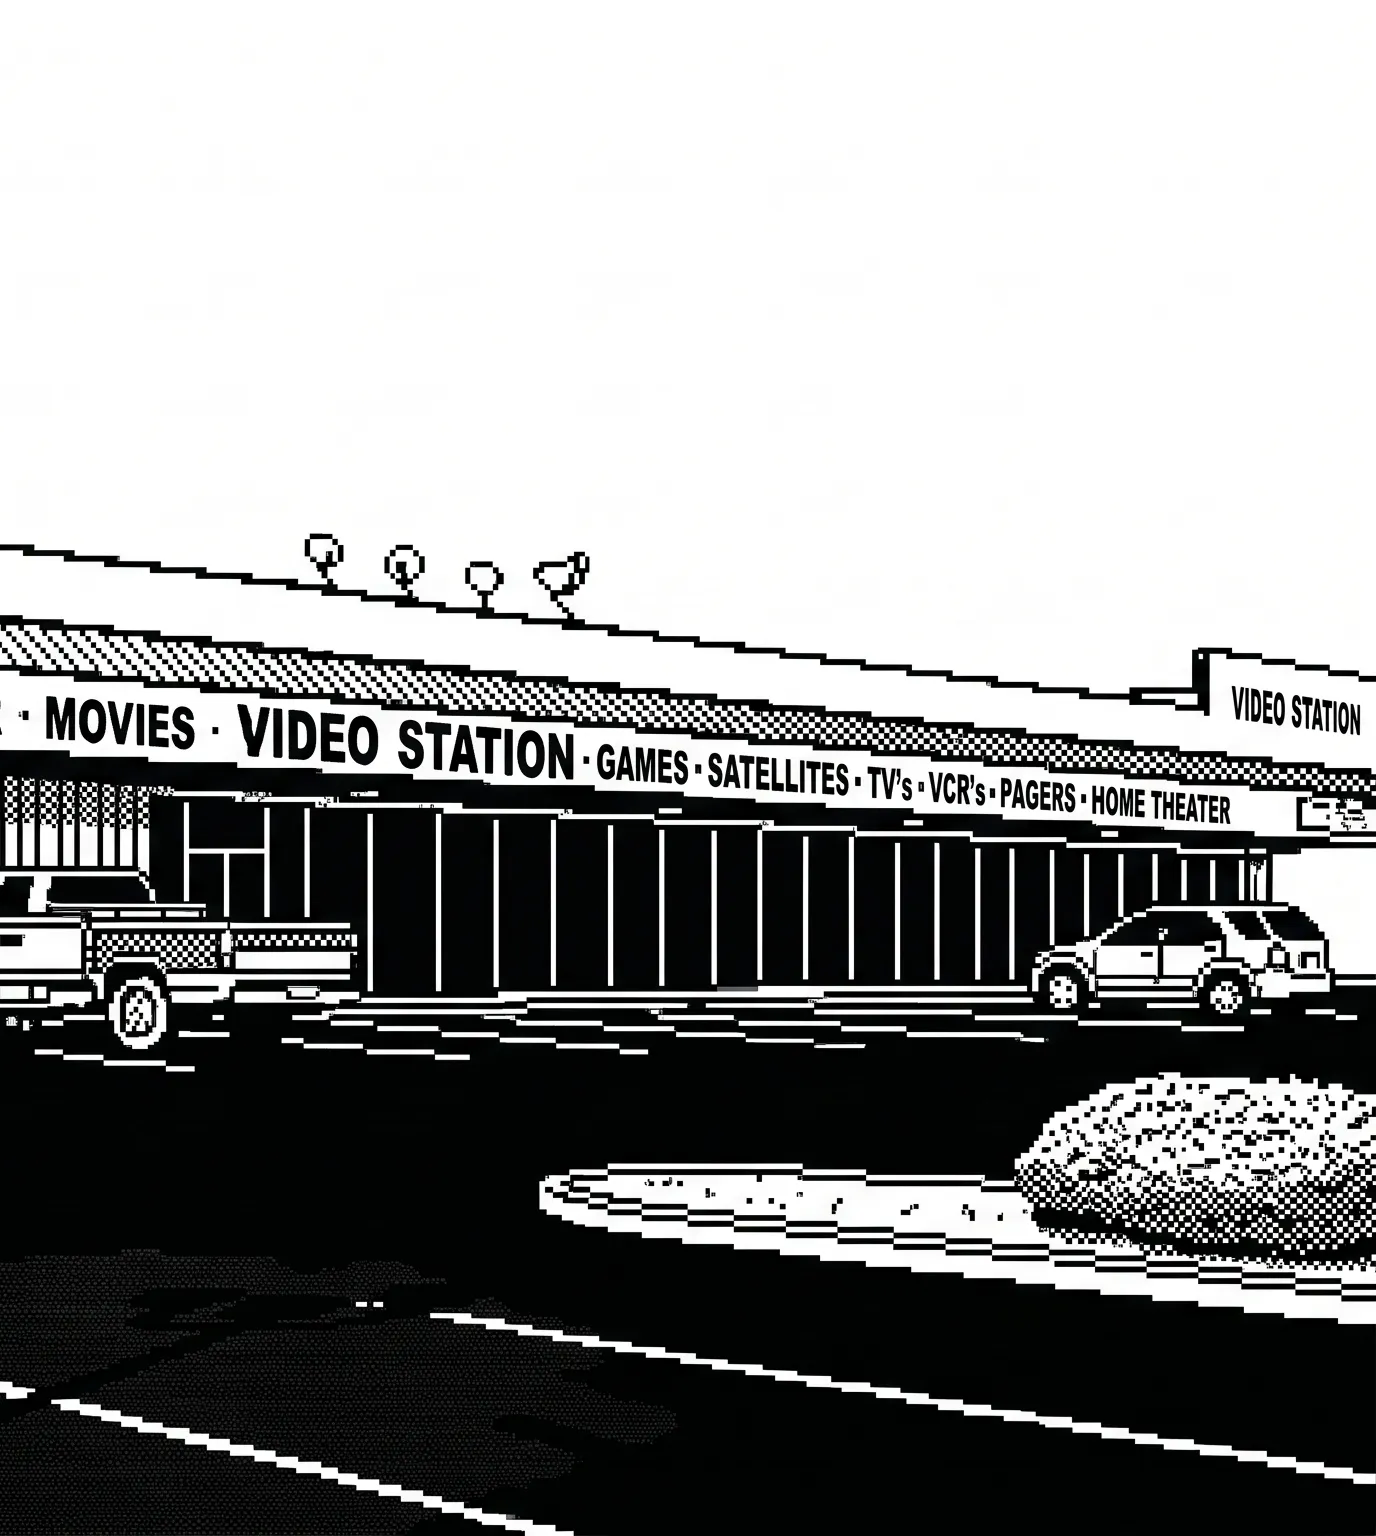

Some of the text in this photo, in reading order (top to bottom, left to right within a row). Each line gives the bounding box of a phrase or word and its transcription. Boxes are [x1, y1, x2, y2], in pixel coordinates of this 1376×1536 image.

[1232, 686, 1360, 735] VIDEO STATION
[46, 696, 195, 749] MOVIES
[237, 704, 378, 765] VIDEO
[398, 720, 573, 779] STATION
[597, 744, 688, 785] GAMES
[708, 753, 848, 796] SATELLITES
[868, 767, 912, 801] TV's
[929, 772, 985, 806] VCR's
[1001, 778, 1075, 812] PAGERS
[1092, 786, 1145, 817] HOME
[1151, 791, 1230, 824] THEATER
